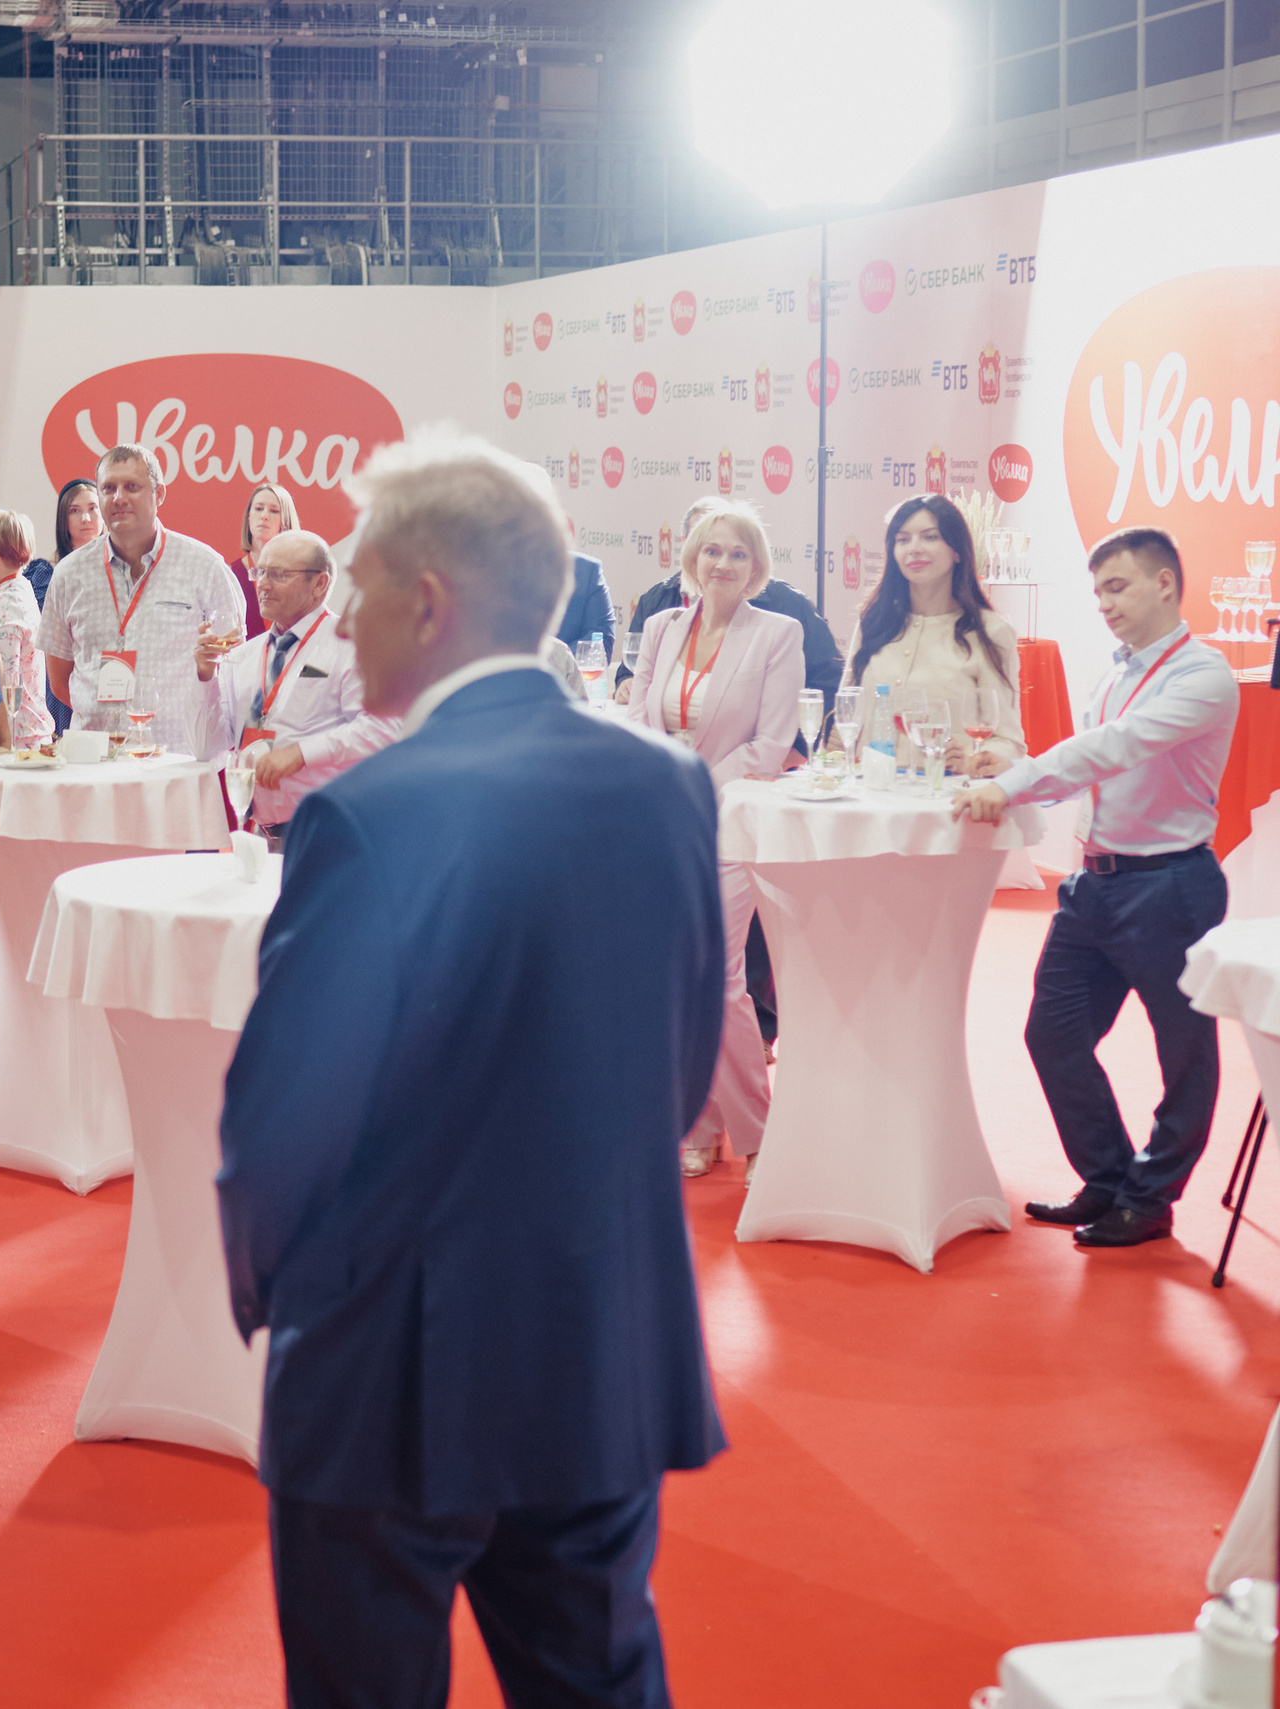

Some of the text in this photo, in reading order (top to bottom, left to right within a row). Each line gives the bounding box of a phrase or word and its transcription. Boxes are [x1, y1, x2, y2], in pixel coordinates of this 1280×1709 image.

[1009, 256, 1036, 285] ВТБ
[776, 290, 795, 314] ВТБ
[612, 314, 626, 334] ВТБ
[943, 364, 968, 390] ВТБ
[730, 379, 748, 401] ВТБ
[75, 398, 360, 490] Увелка
[695, 461, 711, 481] ВТБ
[893, 463, 916, 487] ВТБ
[992, 455, 1029, 483] Увелка
[638, 536, 653, 555] ВТБ
